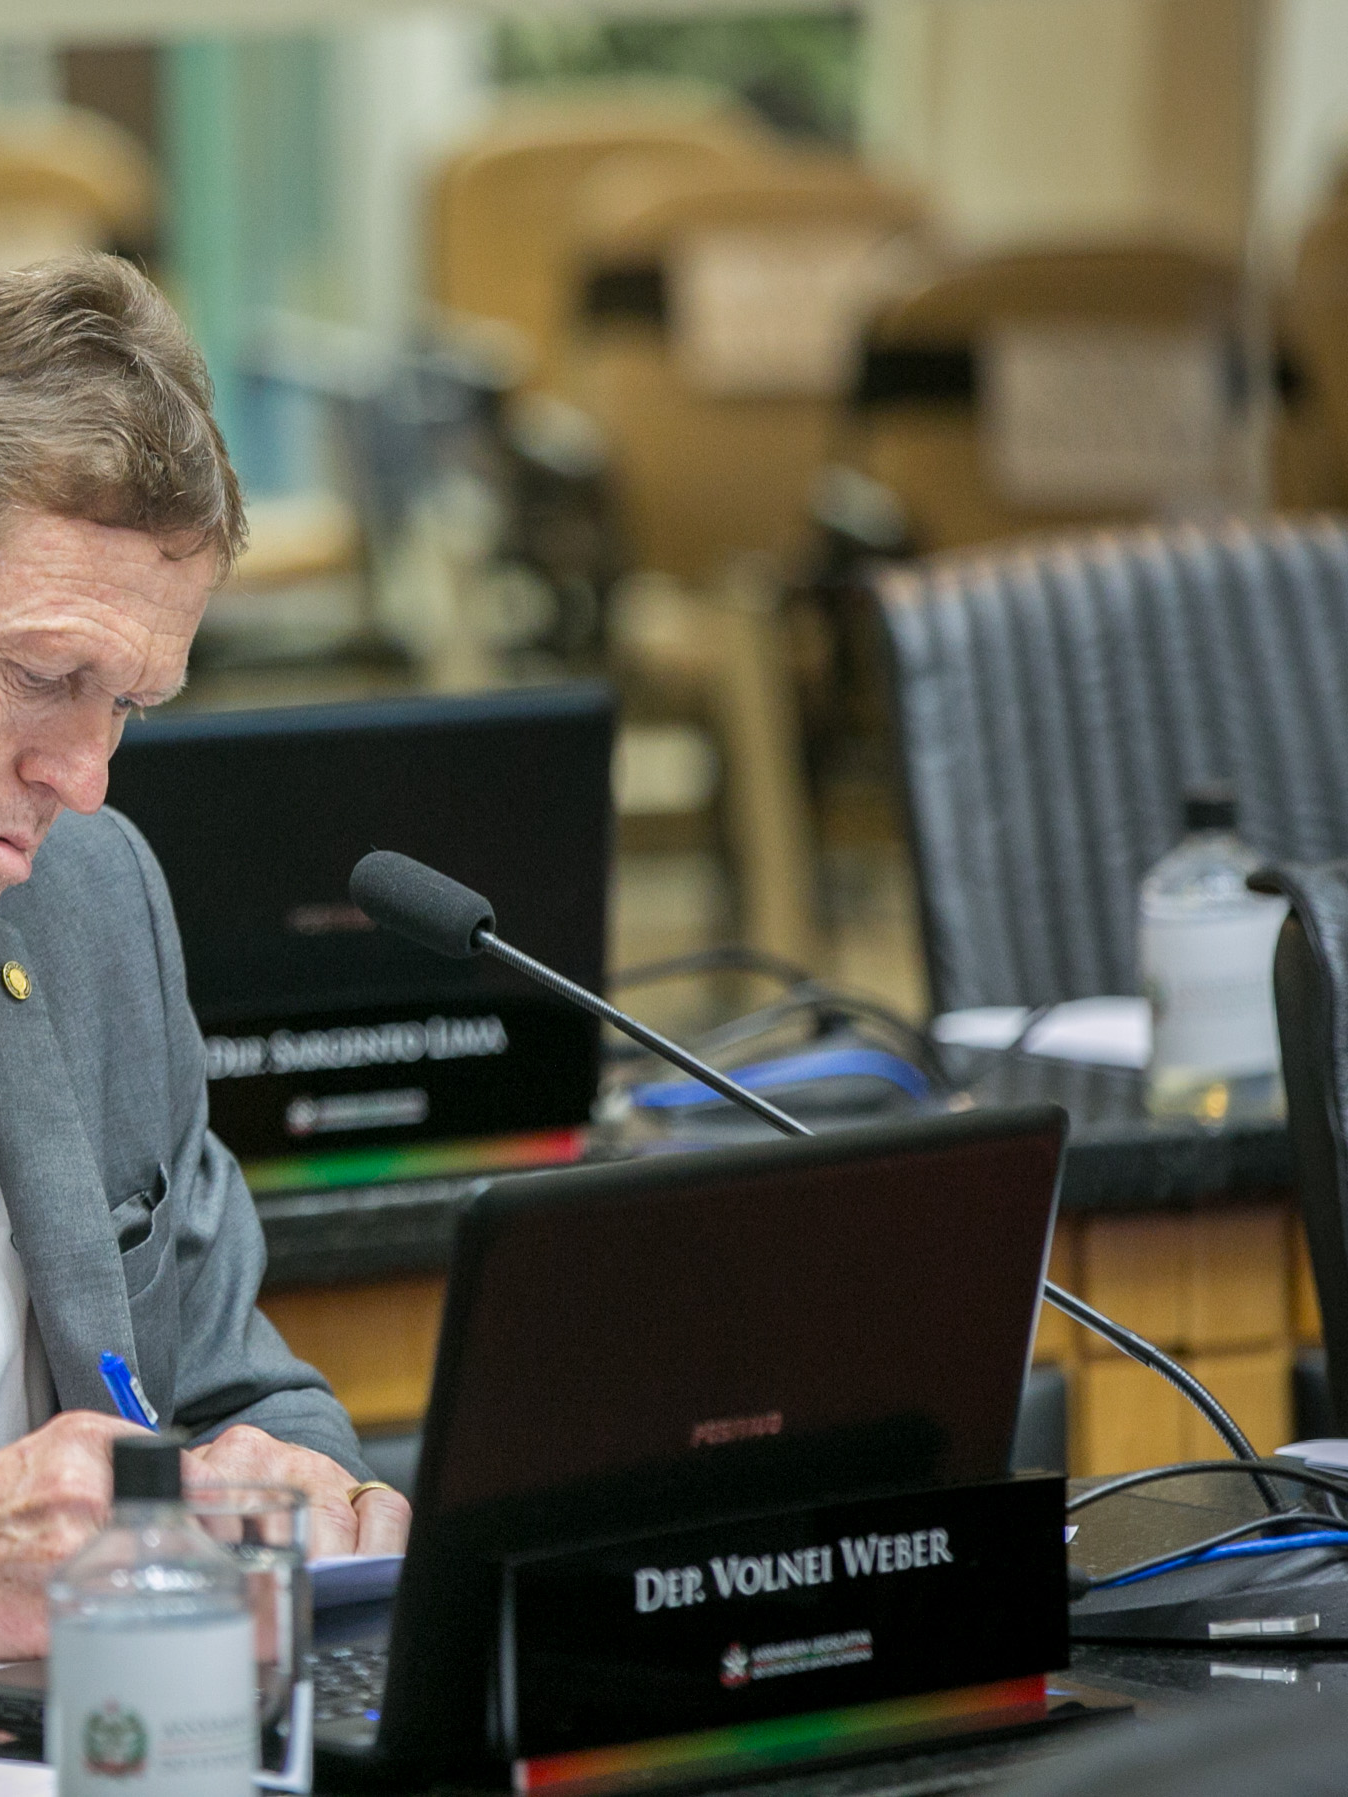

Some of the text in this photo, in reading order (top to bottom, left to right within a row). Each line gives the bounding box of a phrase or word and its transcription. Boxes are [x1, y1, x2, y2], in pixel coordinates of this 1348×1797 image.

[634, 1527, 953, 1613] DEP. VOLNEI WEBER
